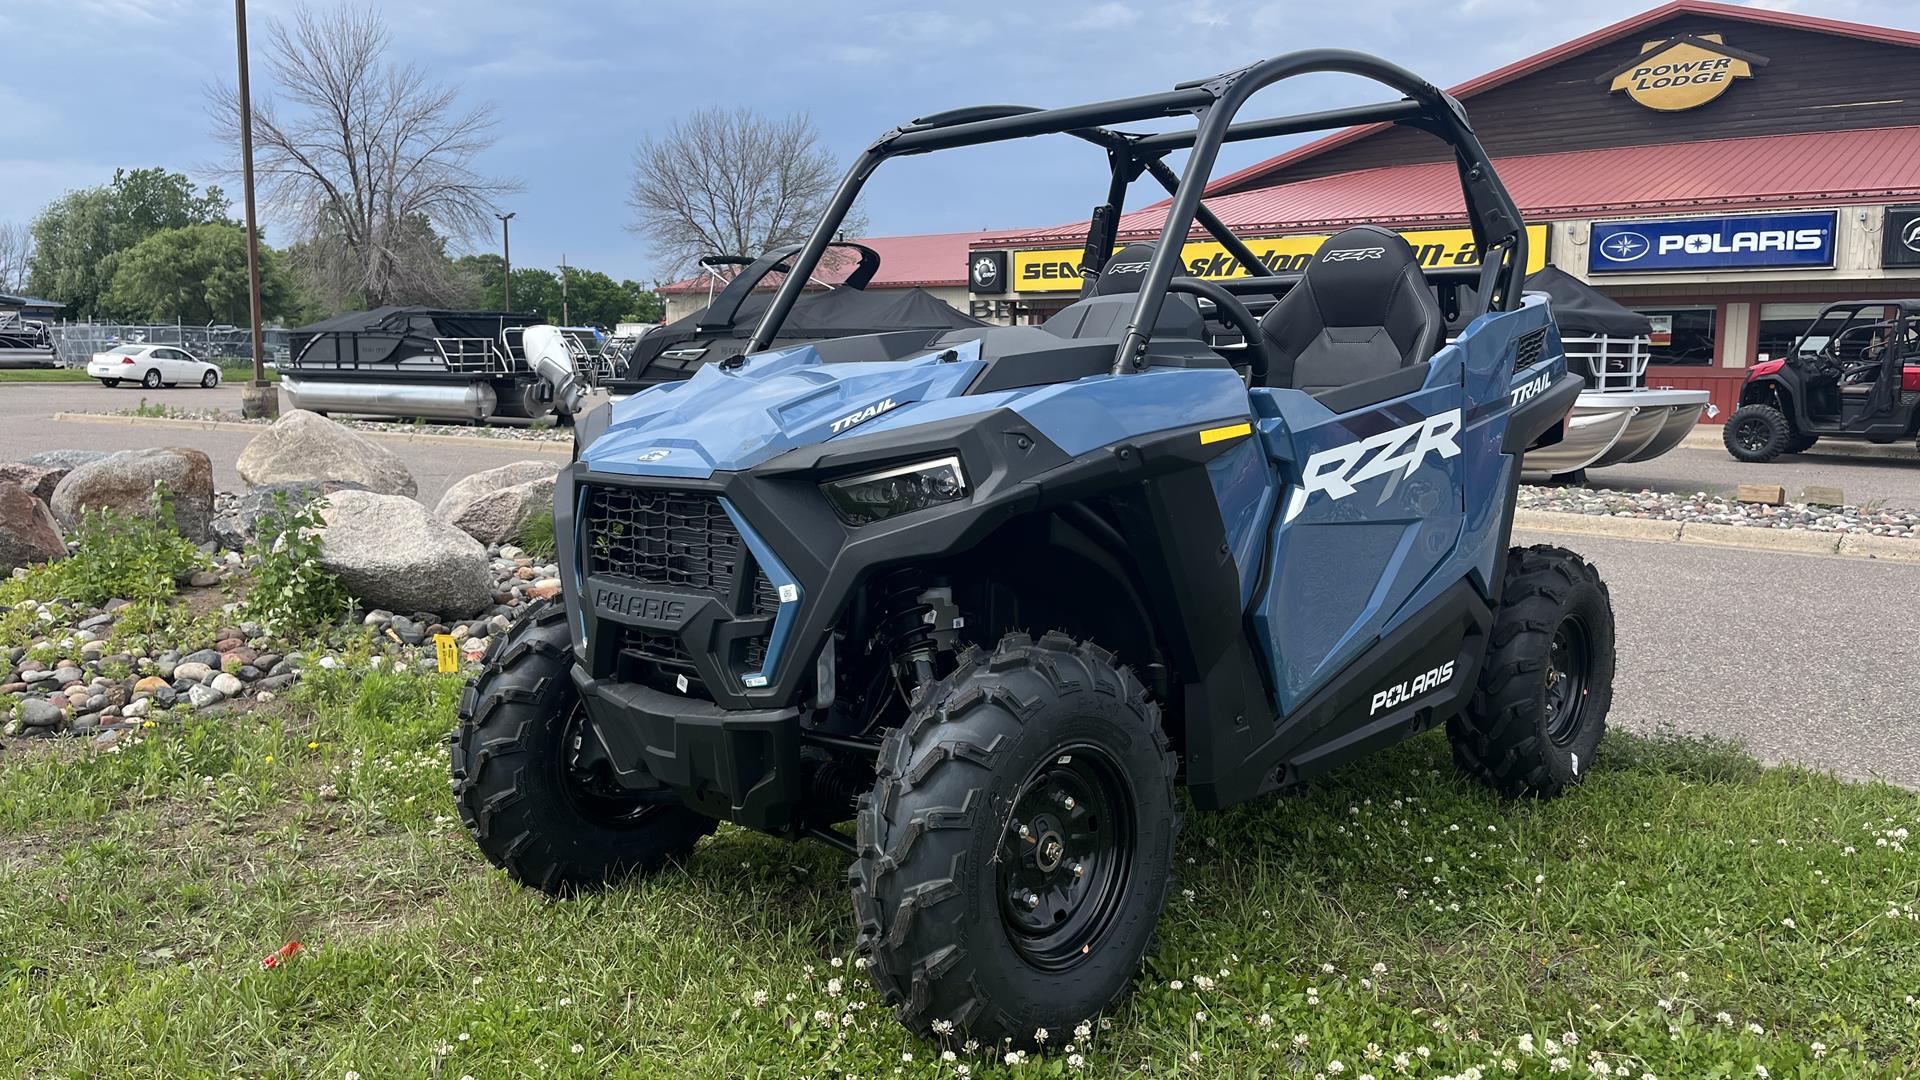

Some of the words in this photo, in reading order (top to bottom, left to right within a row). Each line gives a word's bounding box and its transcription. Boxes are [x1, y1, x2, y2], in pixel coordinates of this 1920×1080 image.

[1631, 57, 1732, 82] POWER
[1635, 70, 1727, 91] LODGE
[1322, 247, 1385, 263] RZR
[1658, 228, 1822, 255] POLARIS
[1510, 370, 1551, 407] TRAIL
[830, 398, 897, 433] TRAIL
[1284, 408, 1462, 525] RZR
[596, 588, 687, 624] POLARIS
[1369, 659, 1455, 716] POLARIS
